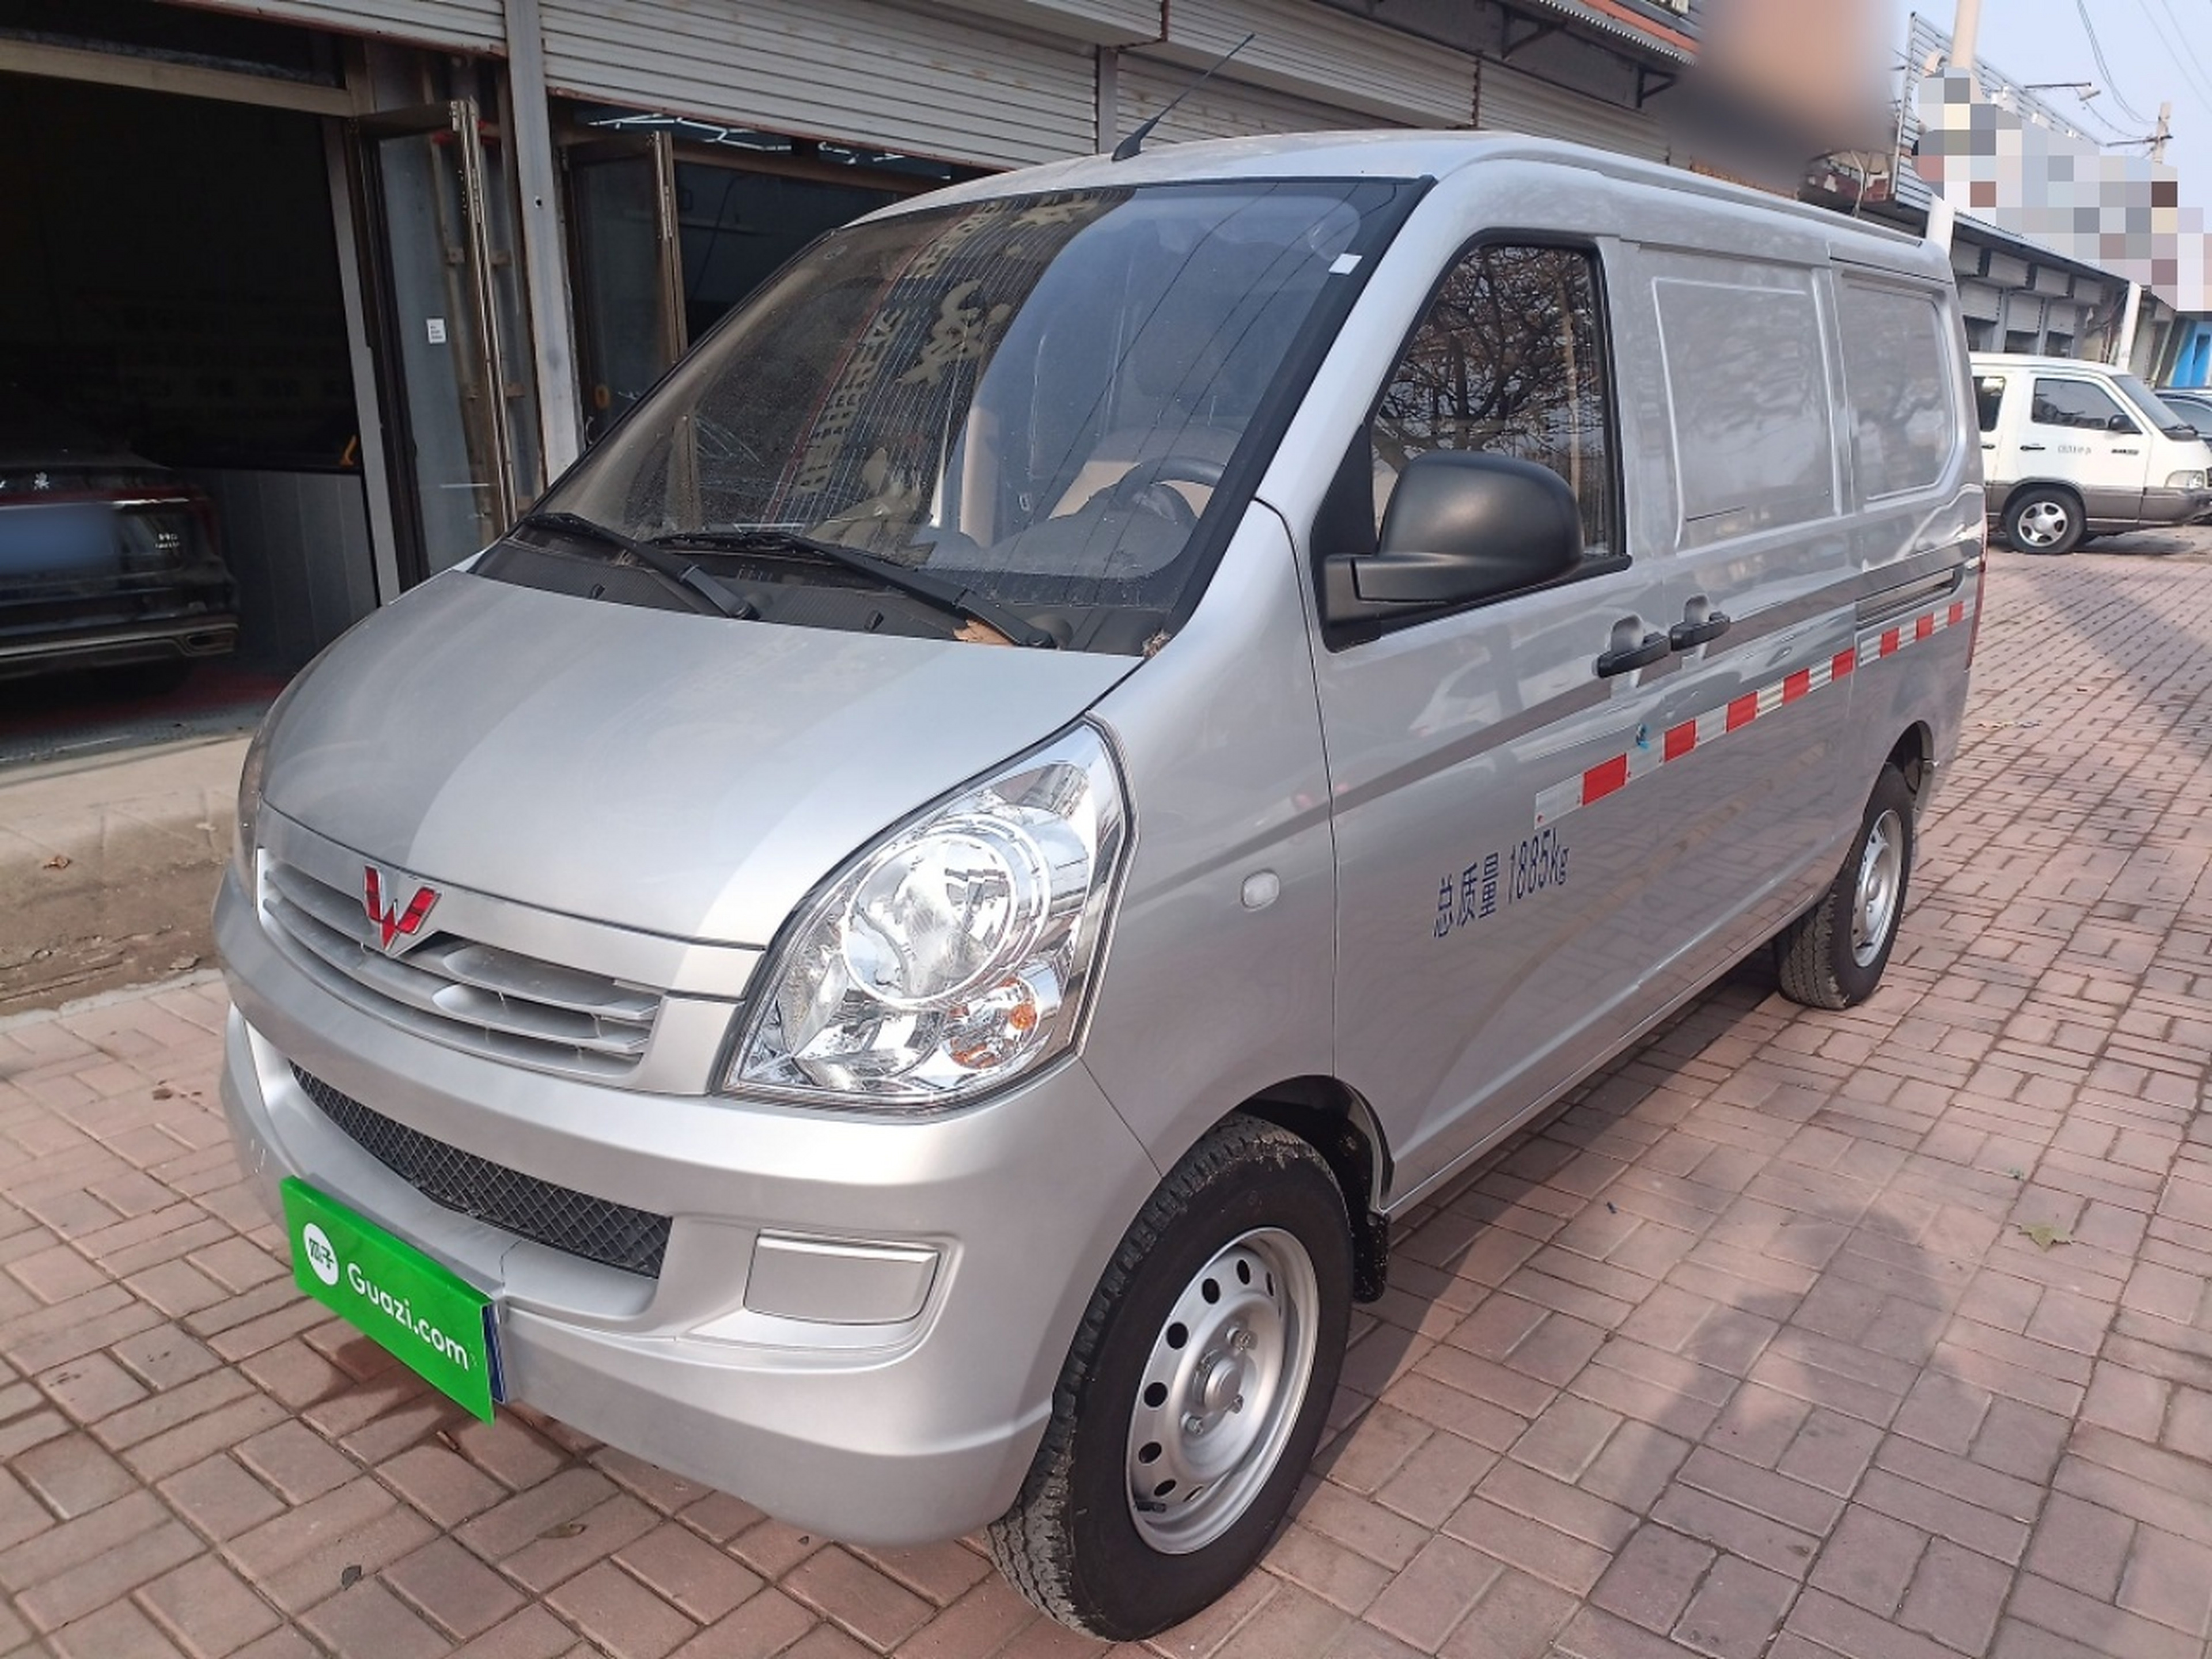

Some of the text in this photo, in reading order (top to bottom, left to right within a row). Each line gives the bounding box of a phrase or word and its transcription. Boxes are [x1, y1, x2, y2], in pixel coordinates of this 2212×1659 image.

[1433, 852, 1498, 938] 总质量
[347, 1262, 469, 1371] Guazi.com
